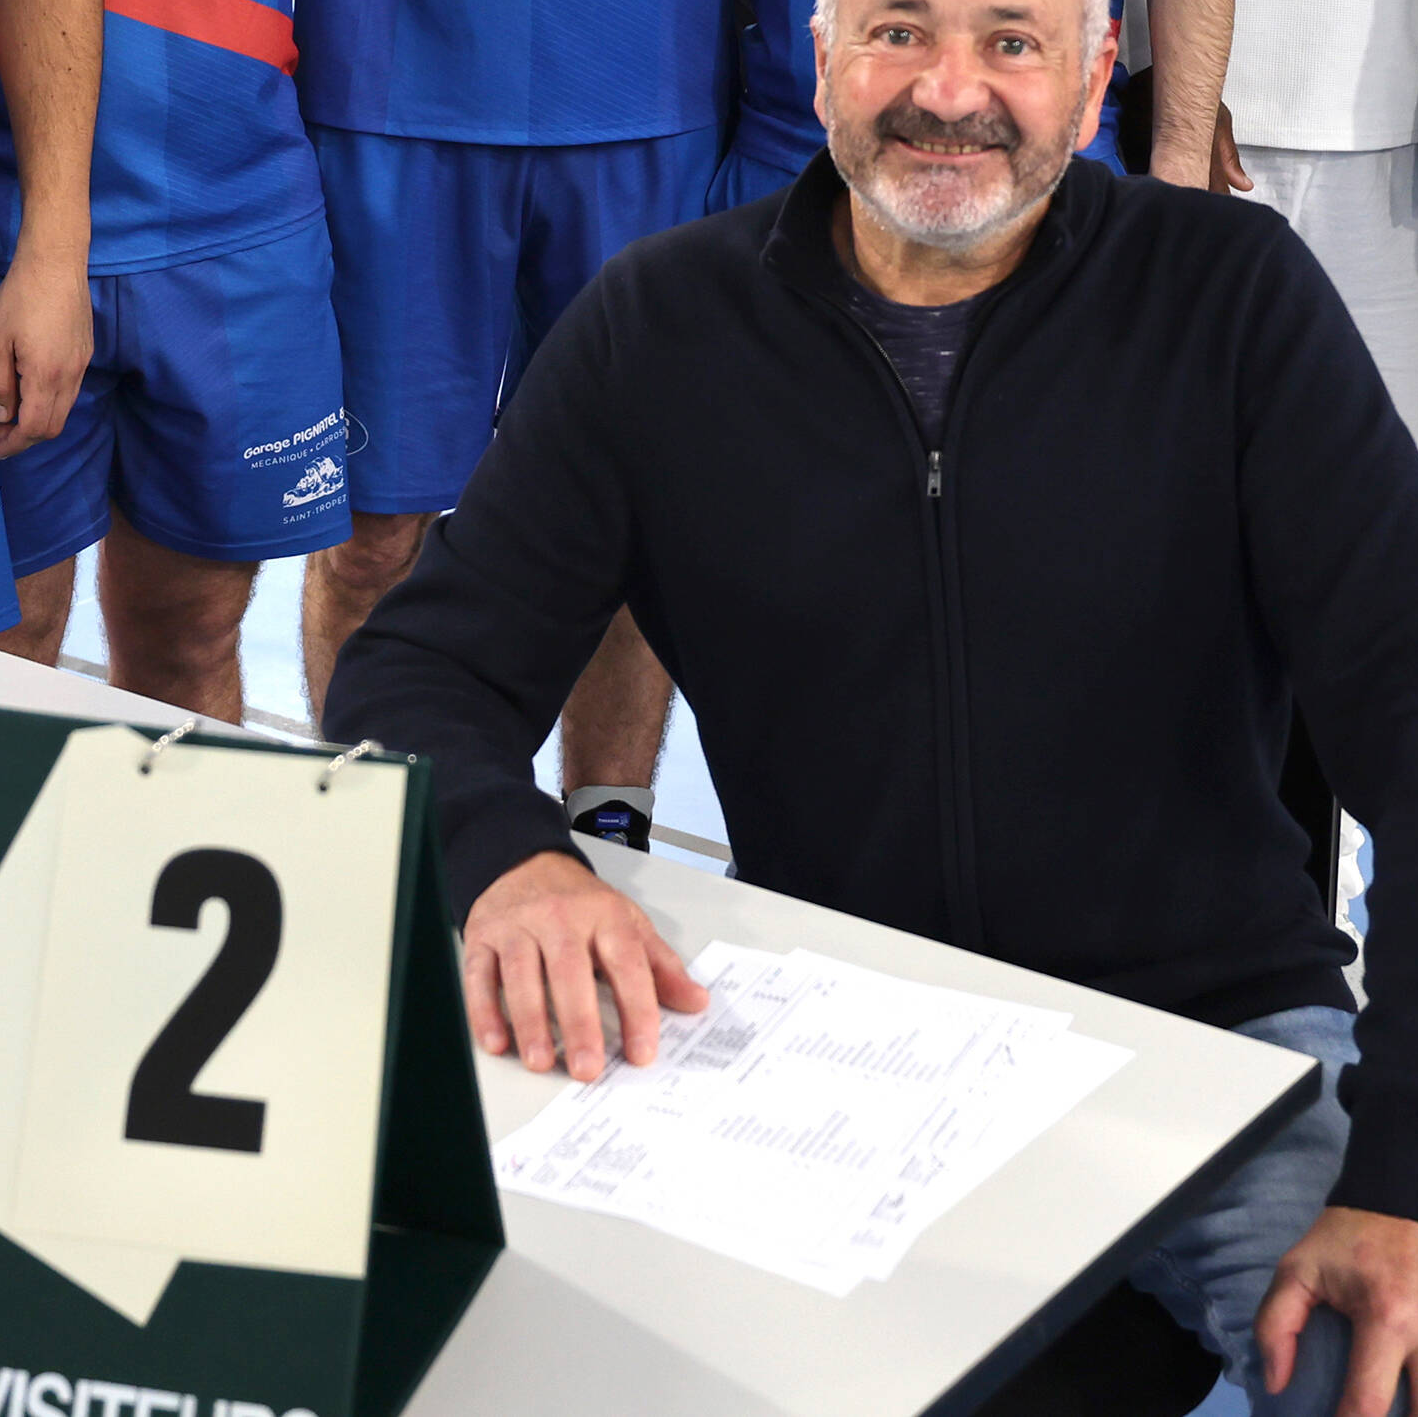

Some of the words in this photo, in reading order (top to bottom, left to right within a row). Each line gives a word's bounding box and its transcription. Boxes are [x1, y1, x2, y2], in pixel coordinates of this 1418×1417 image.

[243, 438, 290, 460] Garage
[292, 411, 339, 446] PIGNATEL
[250, 448, 308, 470] MECANIQUE
[124, 846, 285, 1154] 2
